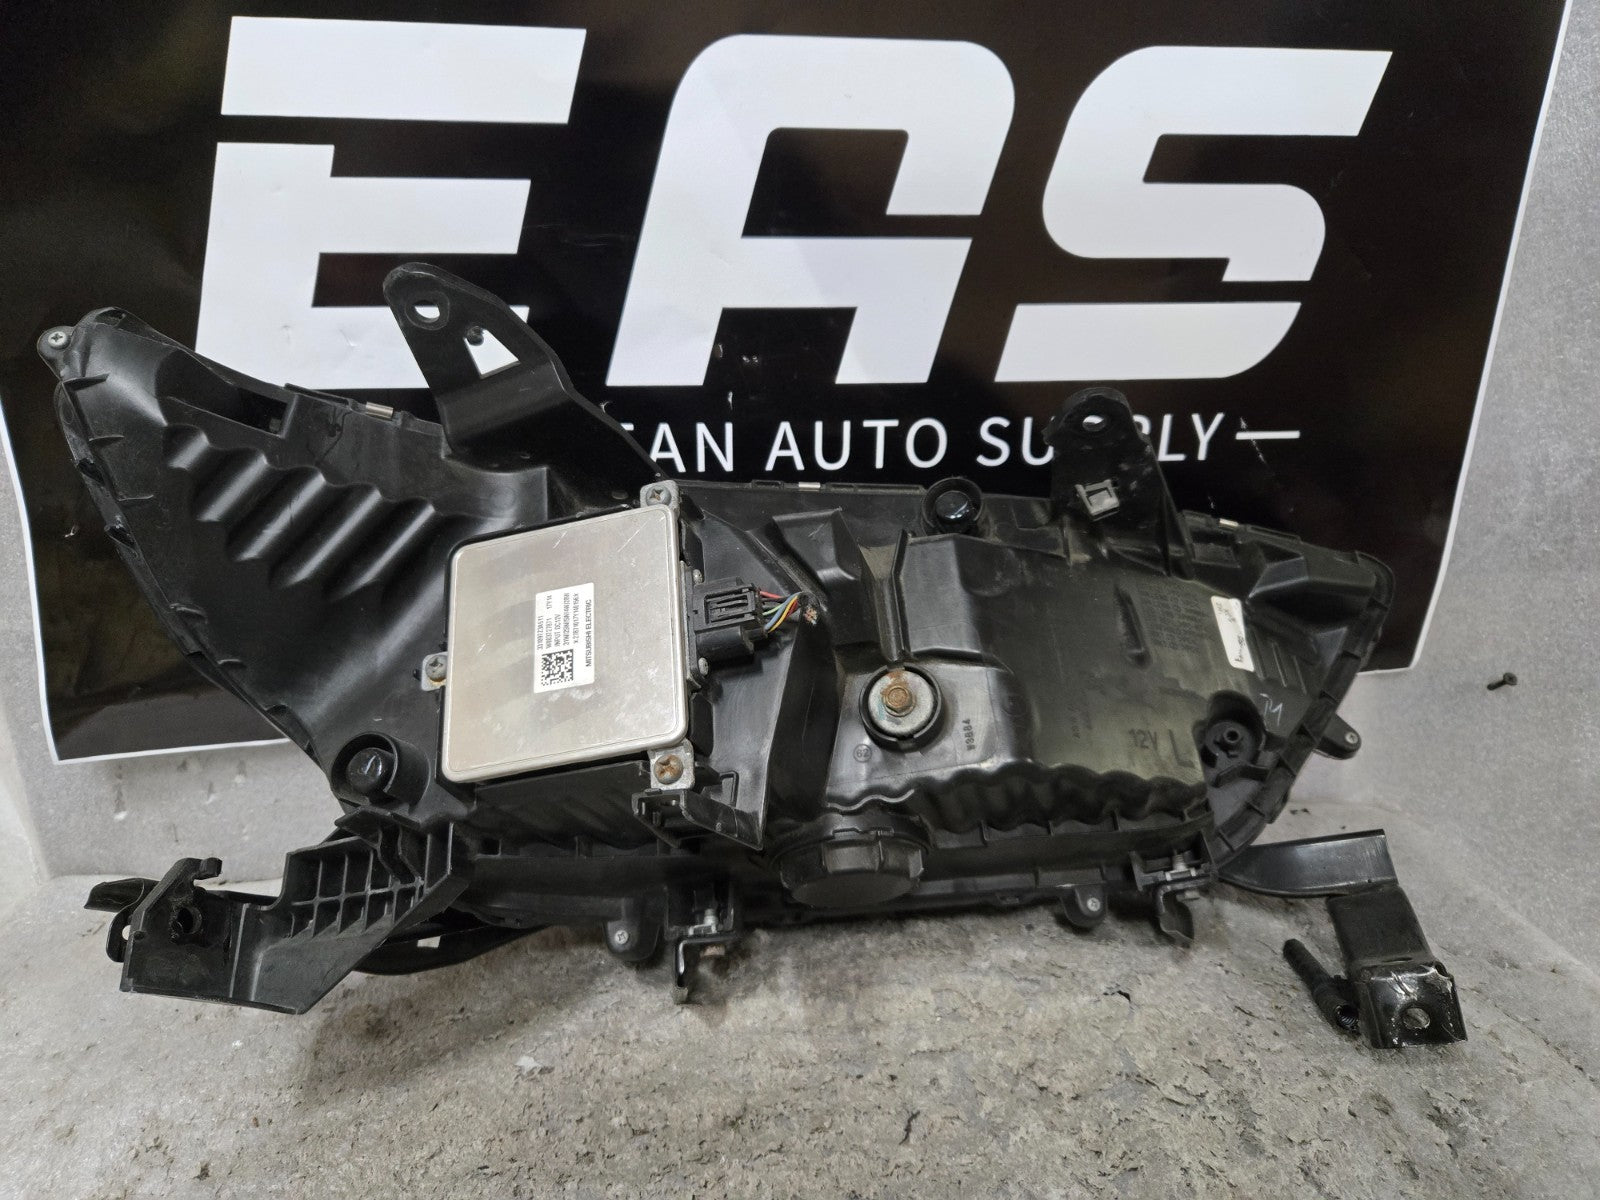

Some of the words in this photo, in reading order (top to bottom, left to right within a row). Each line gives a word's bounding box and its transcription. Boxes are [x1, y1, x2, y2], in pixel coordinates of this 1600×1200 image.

[195, 16, 1393, 390] EAS
[620, 421, 734, 473] AN
[765, 417, 949, 472] AUTO
[976, 412, 1225, 467] SULY
[585, 599, 593, 630] ELECTRIC
[585, 630, 593, 667] MITSUBISHI
